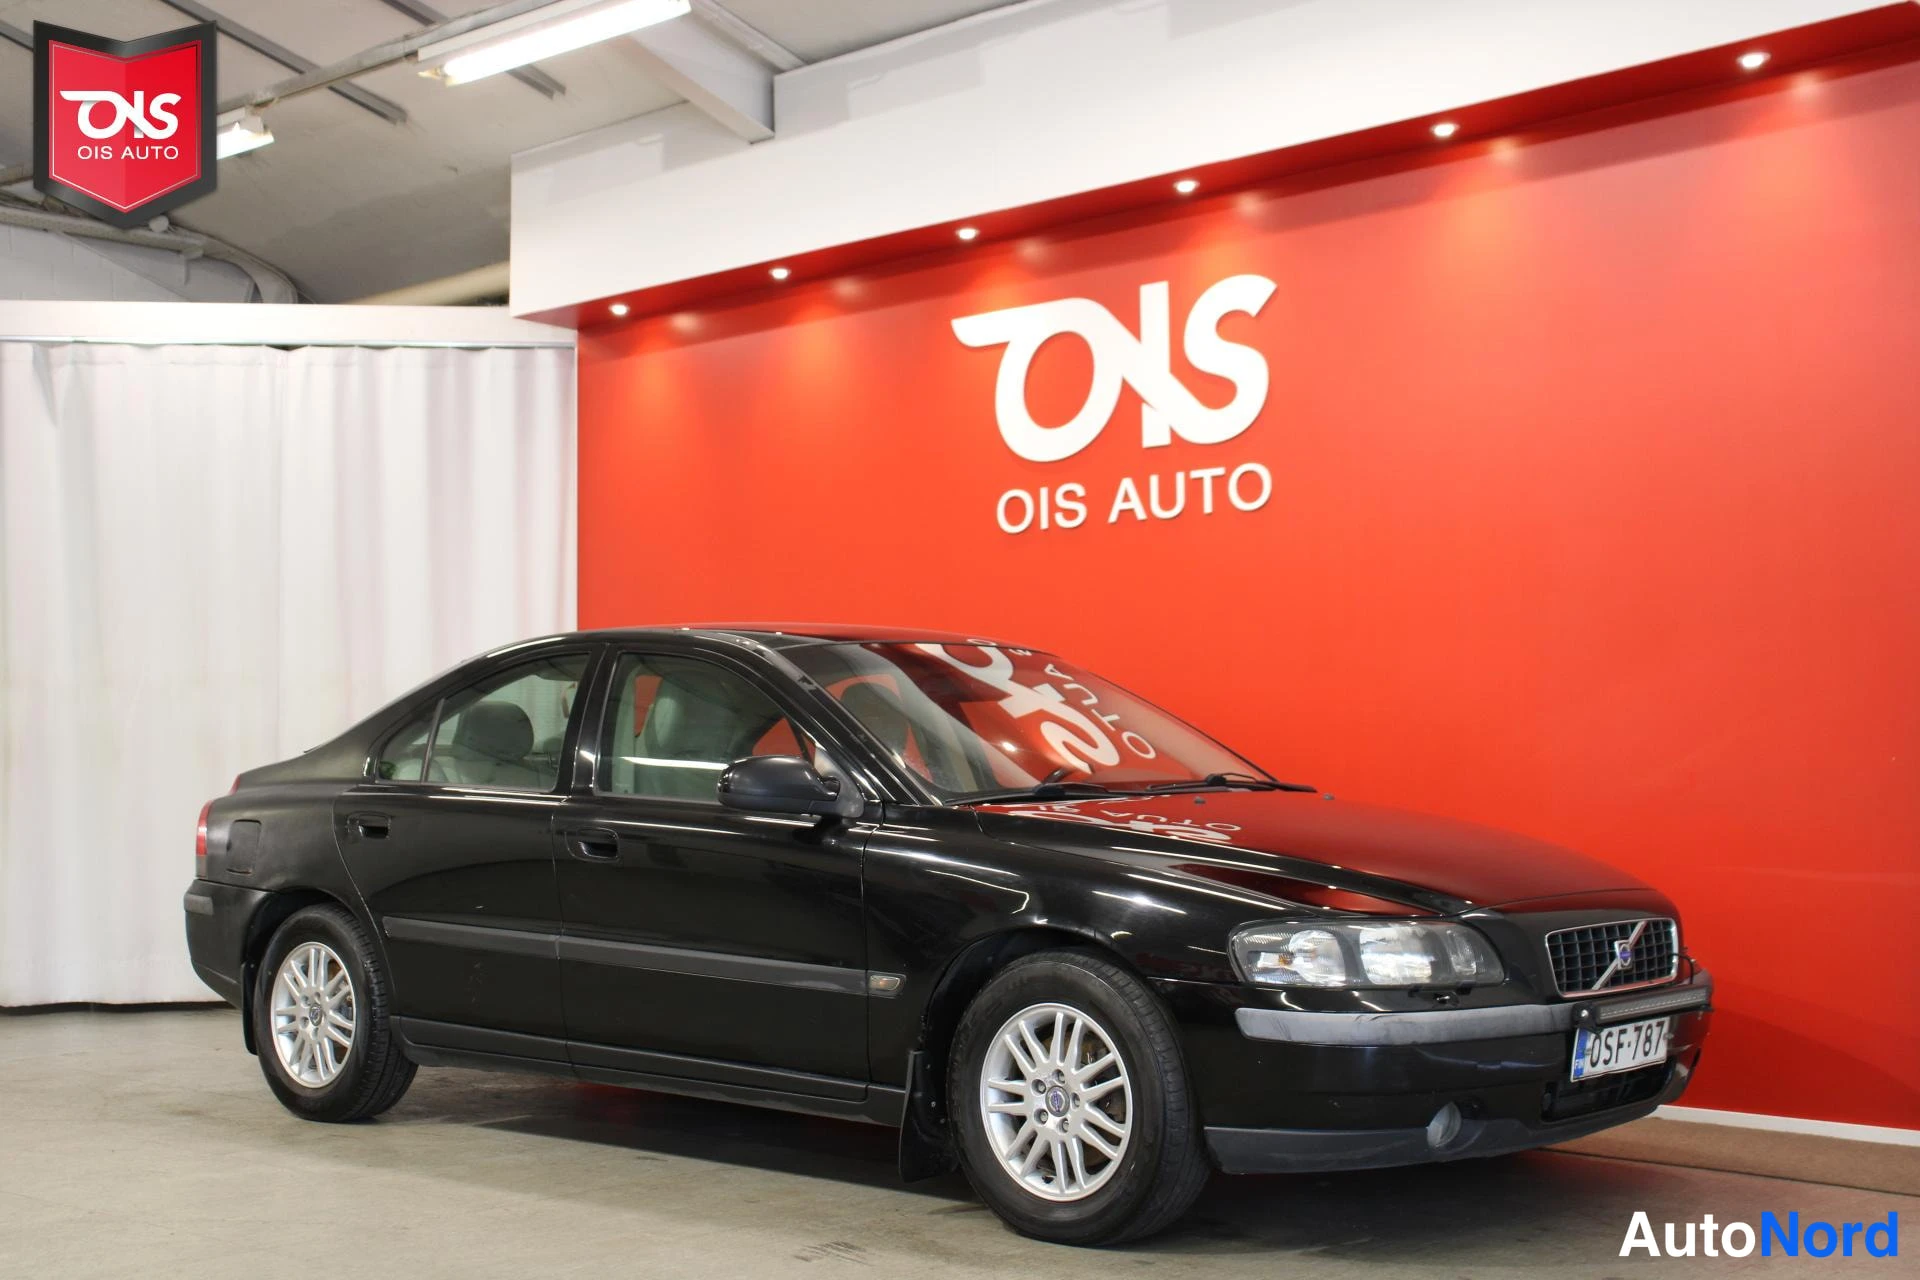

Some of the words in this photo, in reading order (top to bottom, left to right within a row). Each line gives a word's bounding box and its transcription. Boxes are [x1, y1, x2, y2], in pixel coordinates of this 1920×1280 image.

[951, 274, 1277, 462] OIS
[997, 483, 1087, 534] OIS
[1108, 463, 1272, 523] AUTO
[1590, 1021, 1665, 1068] OSF-787
